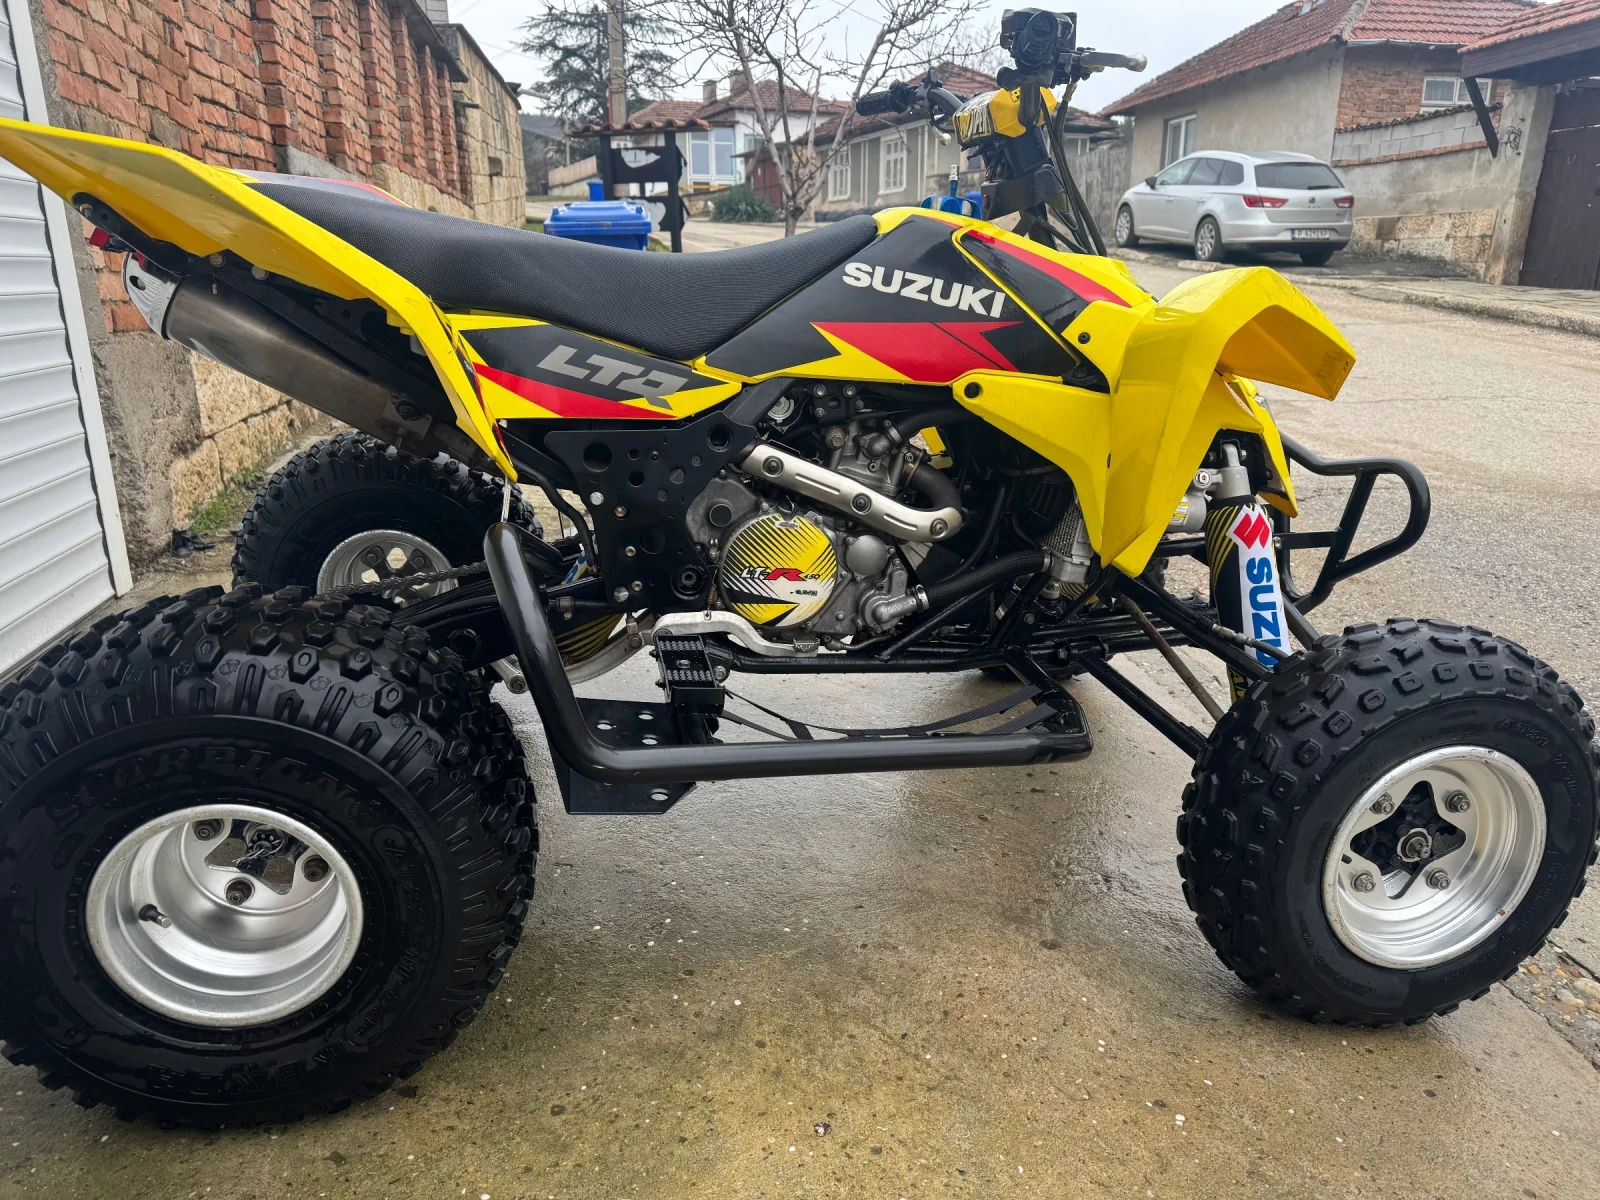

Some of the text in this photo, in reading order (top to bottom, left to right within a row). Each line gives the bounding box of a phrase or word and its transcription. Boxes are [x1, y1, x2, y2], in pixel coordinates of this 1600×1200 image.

[842, 262, 1006, 318] SUZUKI
[537, 344, 689, 411] LTR
[1246, 556, 1281, 668] SUZU
